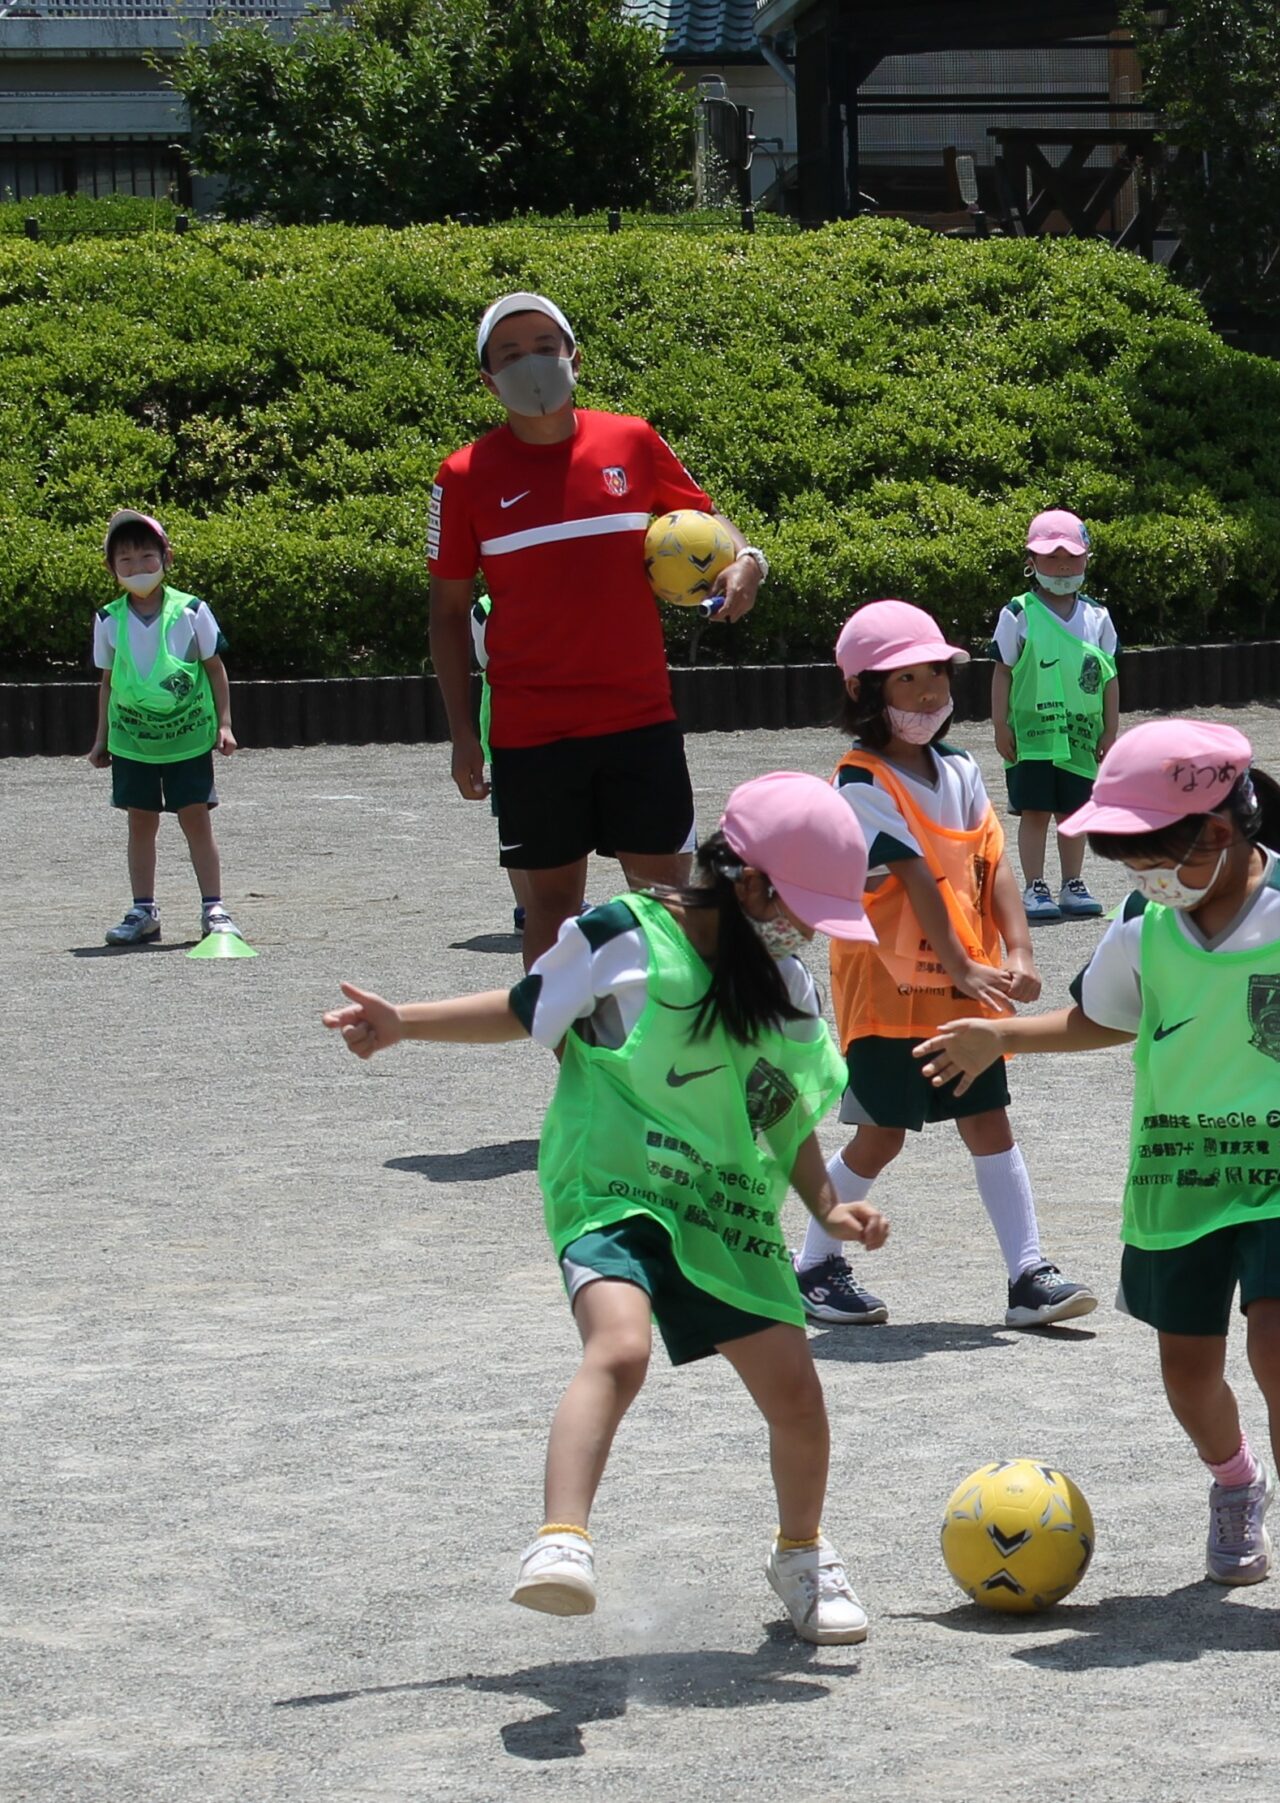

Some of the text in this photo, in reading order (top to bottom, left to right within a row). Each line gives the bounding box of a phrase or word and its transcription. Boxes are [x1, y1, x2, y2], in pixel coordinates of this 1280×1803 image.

[1172, 761, 1237, 792] なつめ
[1197, 1112, 1257, 1129] EneCle
